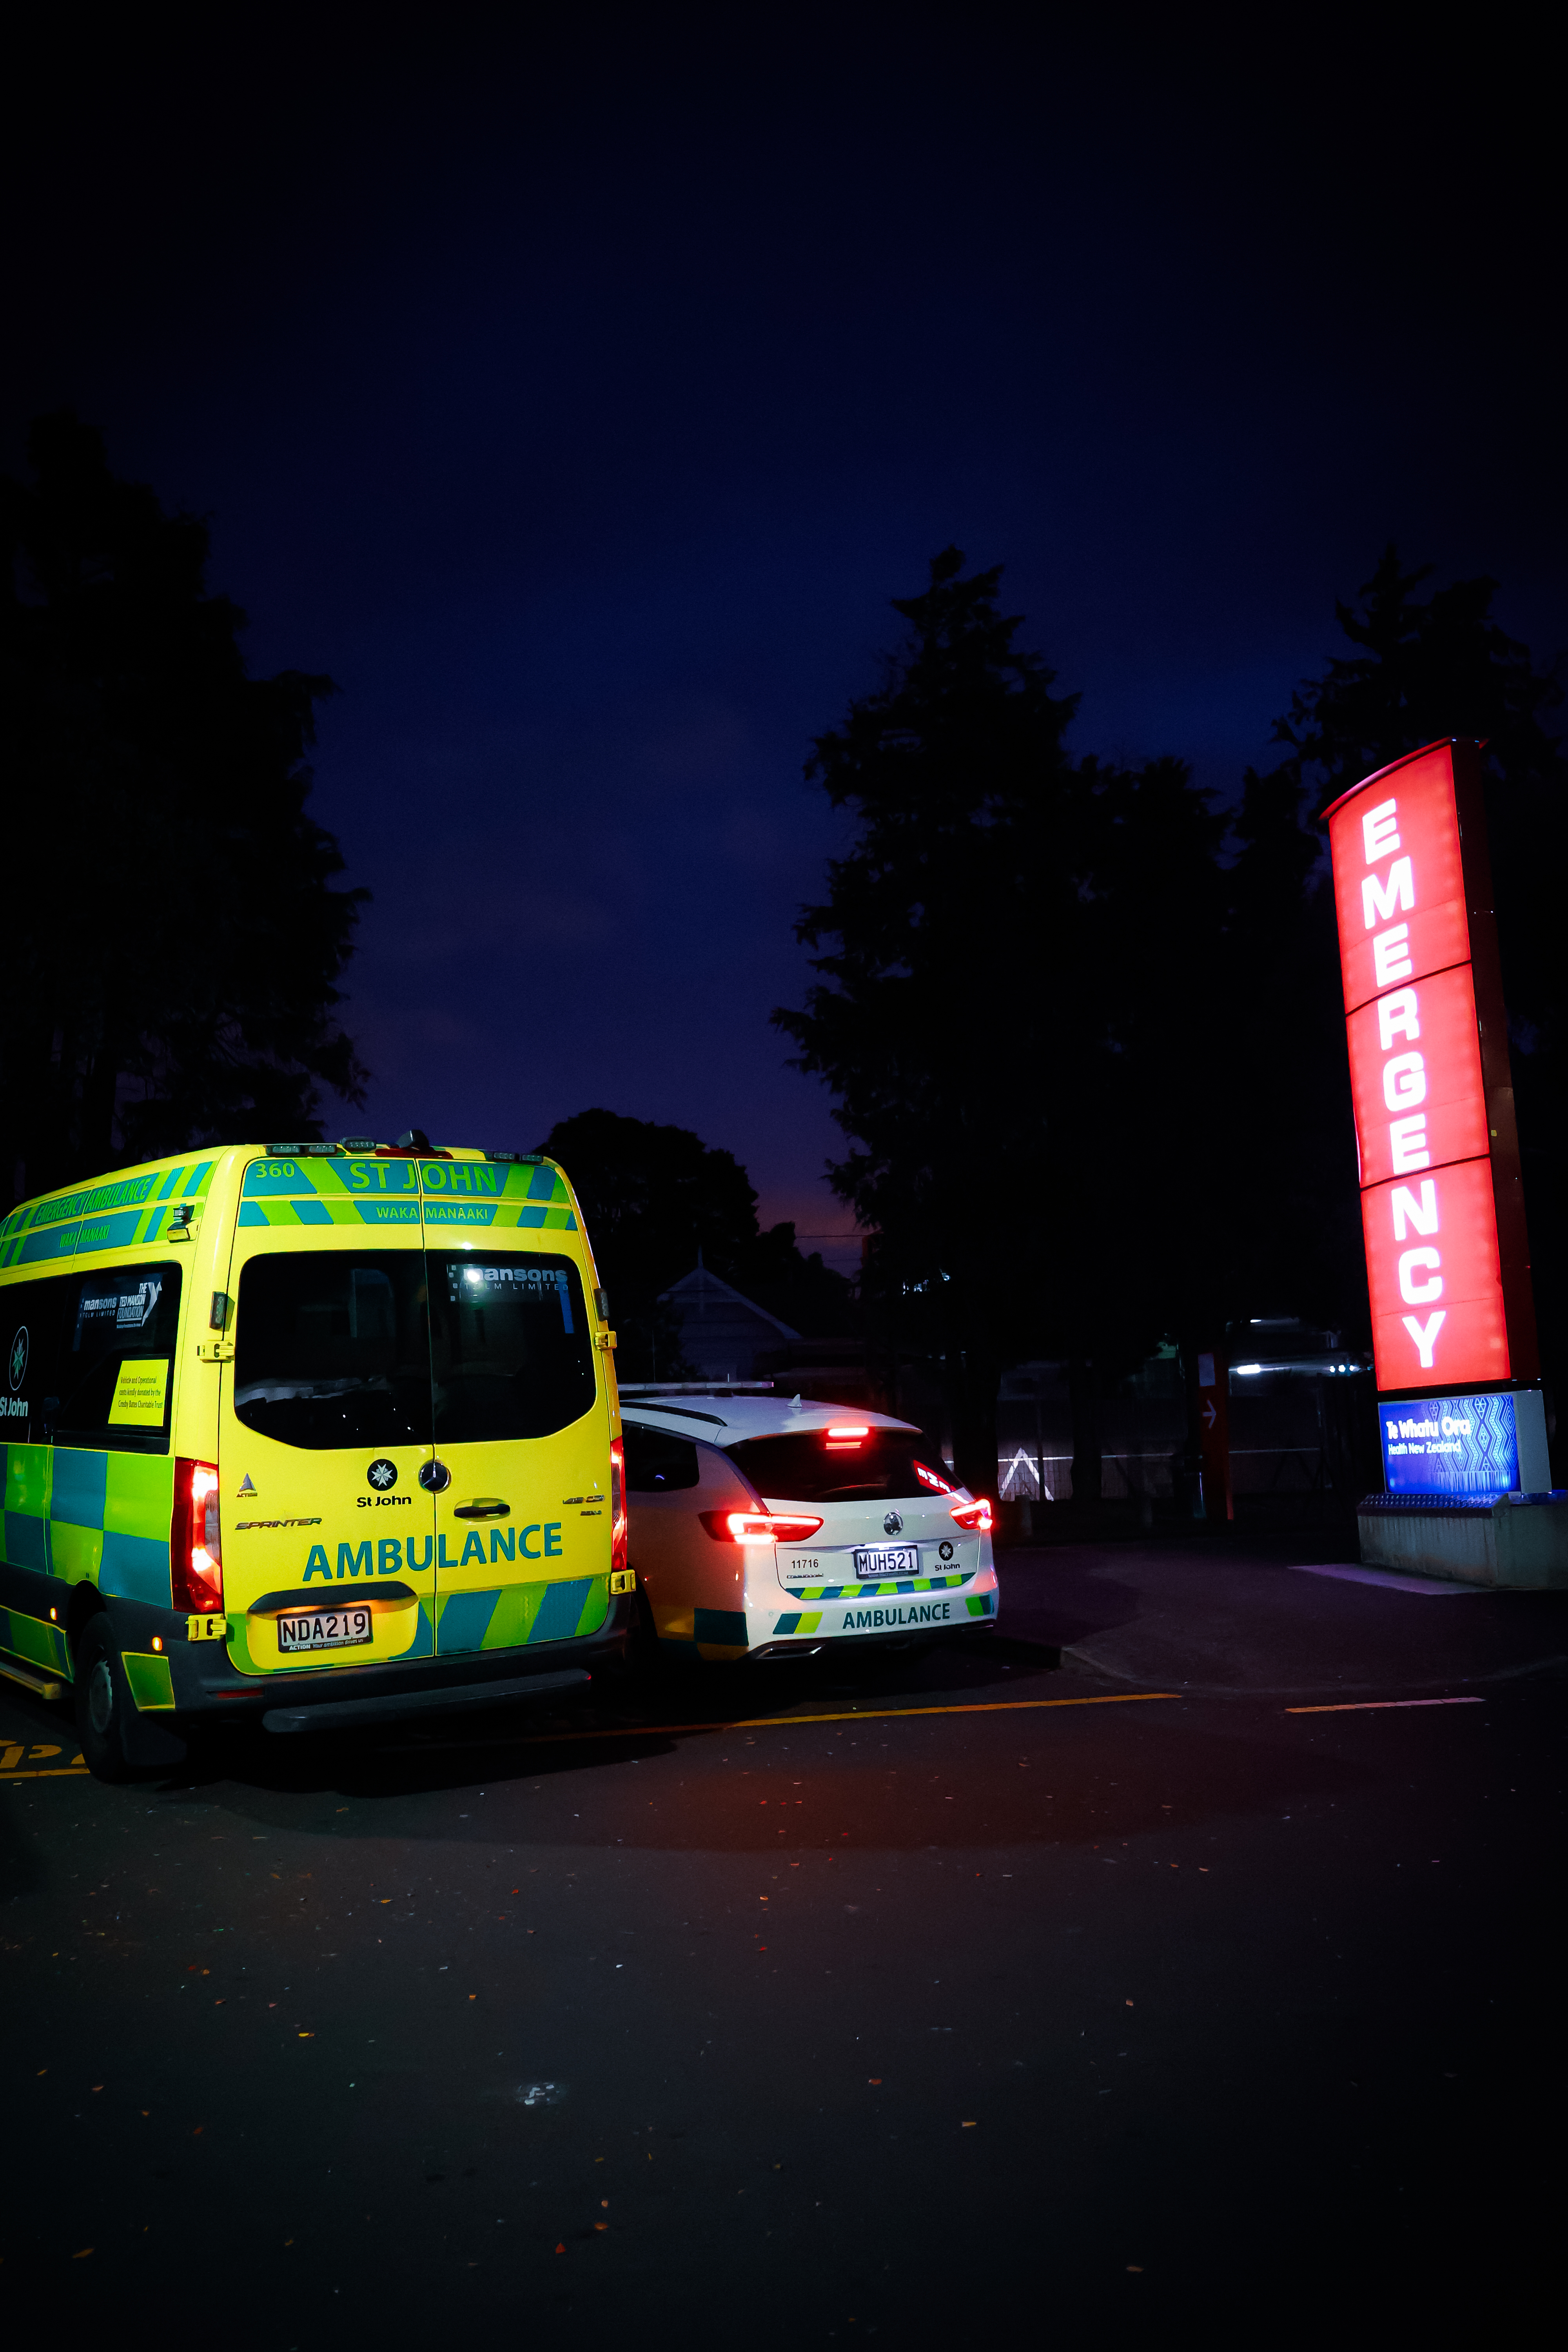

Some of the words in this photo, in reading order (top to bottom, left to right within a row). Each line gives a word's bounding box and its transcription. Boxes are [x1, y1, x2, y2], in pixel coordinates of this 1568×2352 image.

[1361, 798, 1446, 1368] EMERGENCY
[256, 1162, 294, 1178] 360
[350, 1162, 390, 1190] ST
[403, 1163, 498, 1192] JOHN
[35, 1192, 88, 1224] EMERGENCY
[85, 1177, 151, 1211] AMBULANCE
[376, 1207, 418, 1219] WAKA
[60, 1231, 78, 1248] WAKA
[139, 1282, 148, 1294] THE
[84, 1297, 117, 1310] mansons
[119, 1296, 128, 1307] TED
[127, 1294, 146, 1307] MANSON
[117, 1305, 144, 1319] FOUNDATION
[138, 1376, 157, 1385] Operational
[127, 1388, 137, 1397] kindly
[151, 1388, 154, 1397] by
[0, 1396, 7, 1416] St
[7, 1397, 28, 1417] John
[154, 1400, 163, 1408] Trust
[1386, 1421, 1398, 1439] Te
[1398, 1418, 1439, 1439] Whatu
[1441, 1416, 1471, 1436] Ora
[1388, 1443, 1408, 1455] Health
[1408, 1443, 1425, 1454] New
[1426, 1439, 1462, 1454] Zealand
[356, 1497, 372, 1508] St
[375, 1495, 412, 1506] John
[234, 1517, 322, 1530] SPRINTER
[302, 1522, 563, 1582] AMBULANCE
[791, 1559, 818, 1569] 11716
[859, 1551, 913, 1572] MUH521
[842, 1602, 950, 1629] AMBULANCE
[283, 1613, 366, 1643] NDA219
